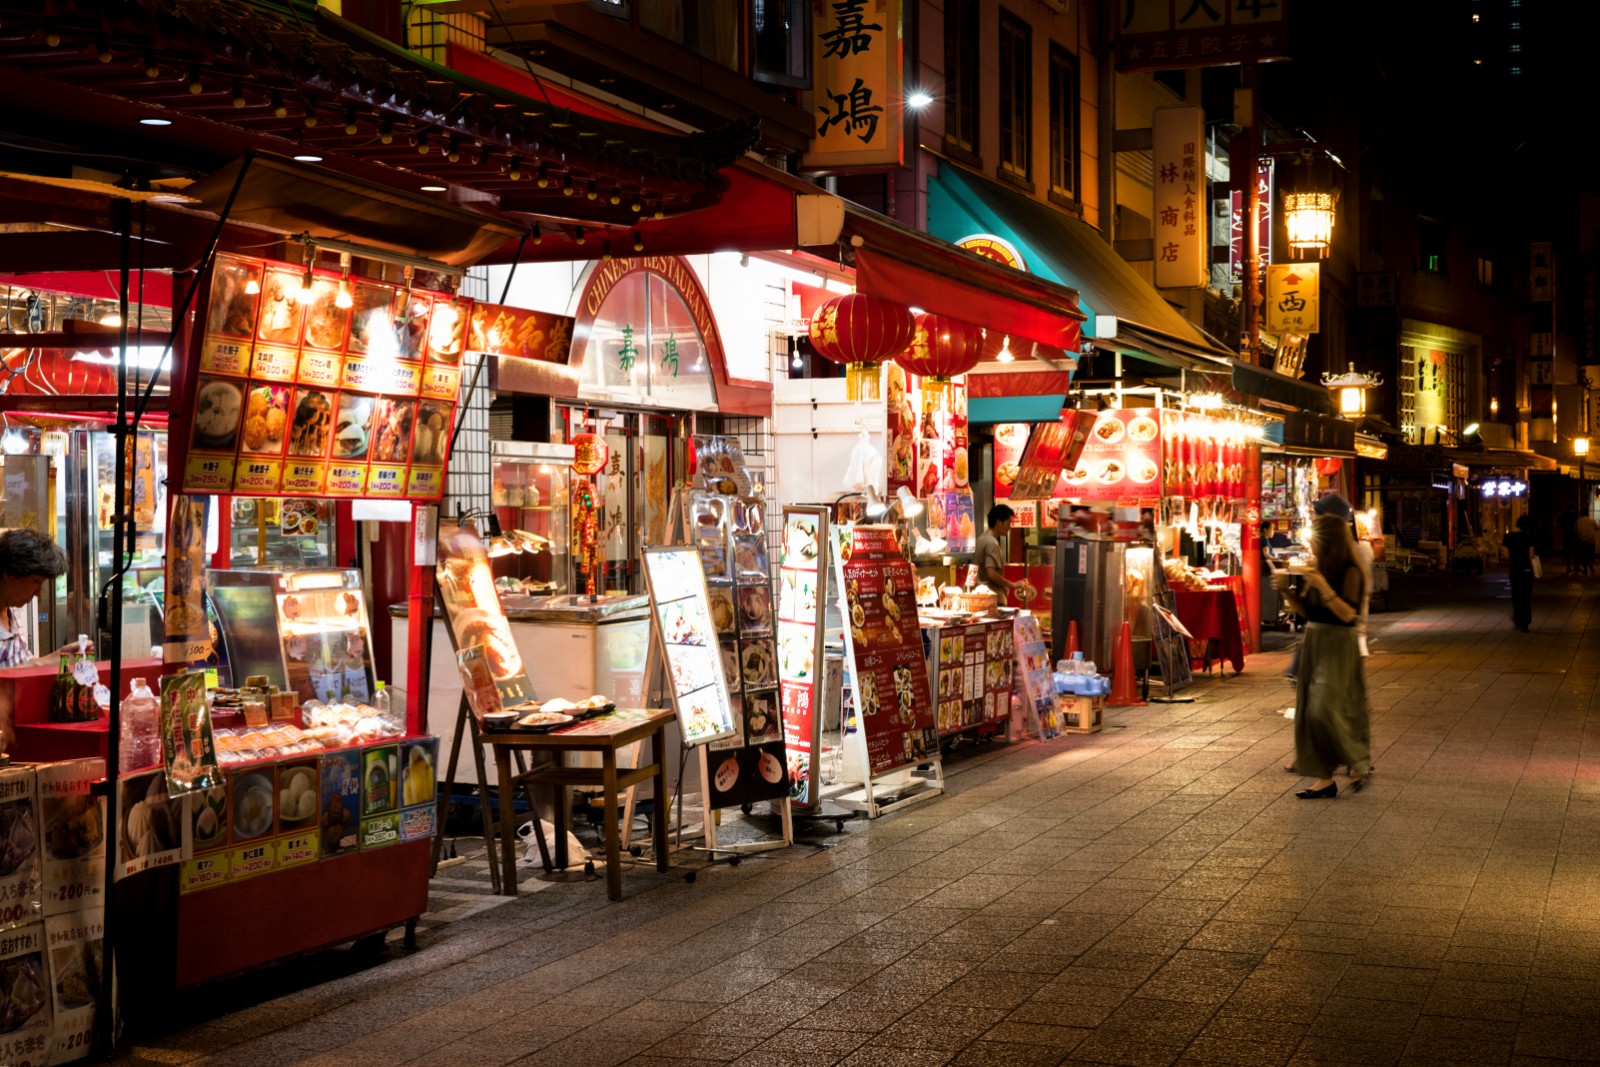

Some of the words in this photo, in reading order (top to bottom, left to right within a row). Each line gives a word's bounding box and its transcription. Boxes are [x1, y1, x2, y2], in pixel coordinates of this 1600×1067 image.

[817, 0, 884, 145] 嘉鴻
[1151, 34, 1251, 60] 五星餃子
[1159, 161, 1180, 263] 林商店
[1182, 142, 1196, 236] 国際輸入食料品
[586, 256, 637, 317] CHINESE
[643, 255, 714, 338] RESTAURANT
[1278, 290, 1306, 314] 西
[1282, 316, 1304, 326] 広場
[617, 323, 680, 379] 嘉鴻
